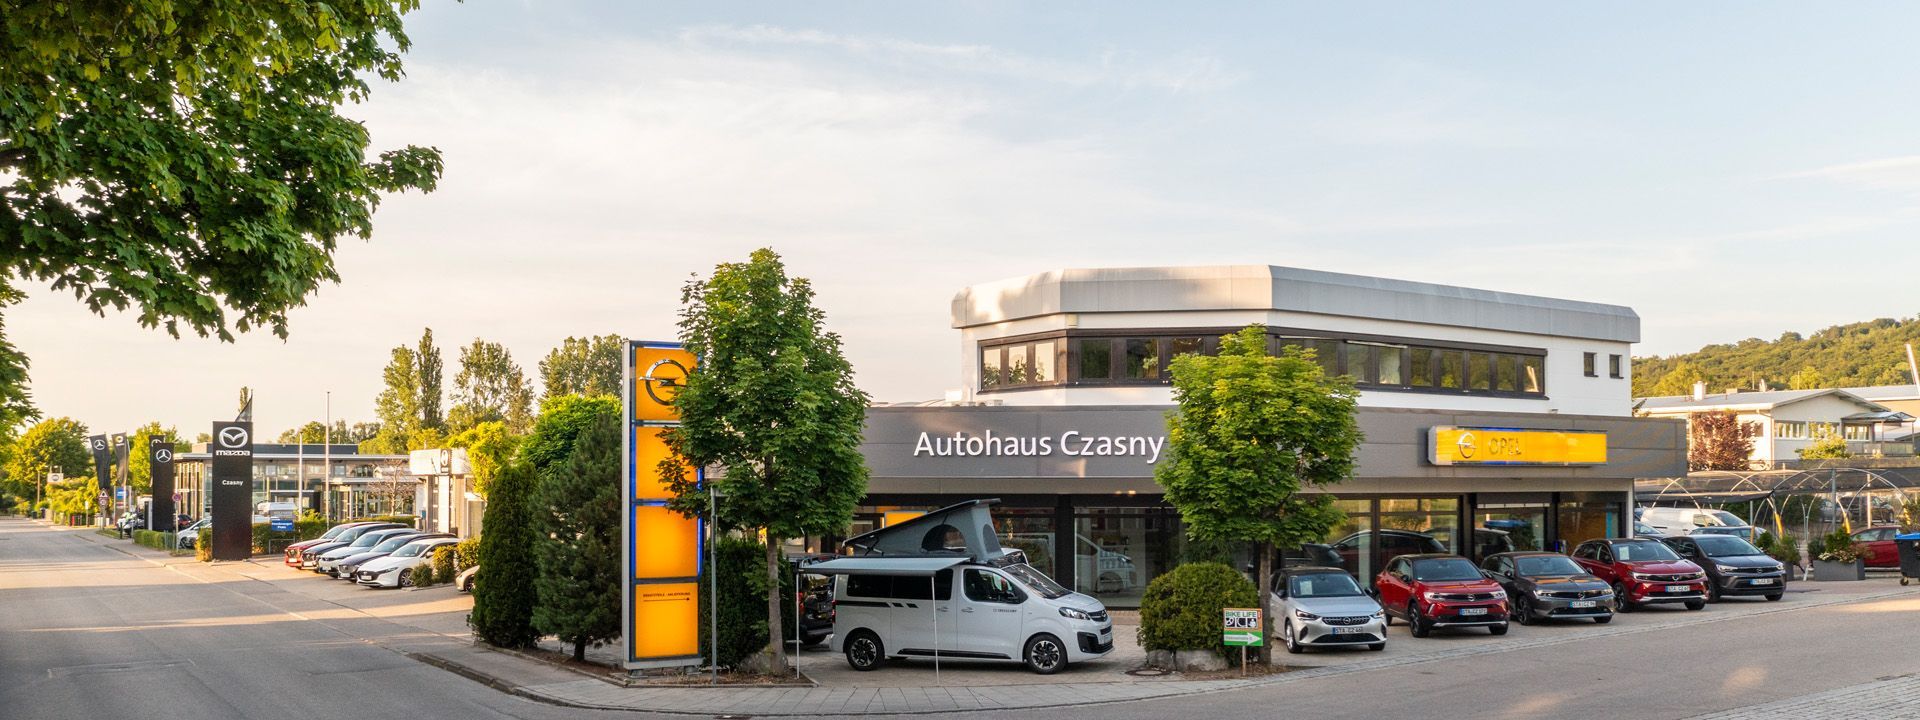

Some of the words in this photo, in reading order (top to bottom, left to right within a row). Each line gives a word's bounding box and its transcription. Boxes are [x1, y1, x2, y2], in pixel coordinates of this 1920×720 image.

[913, 430, 1052, 457] Autohaus
[1060, 431, 1165, 464] Czasny
[1488, 437, 1522, 456] OPEL
